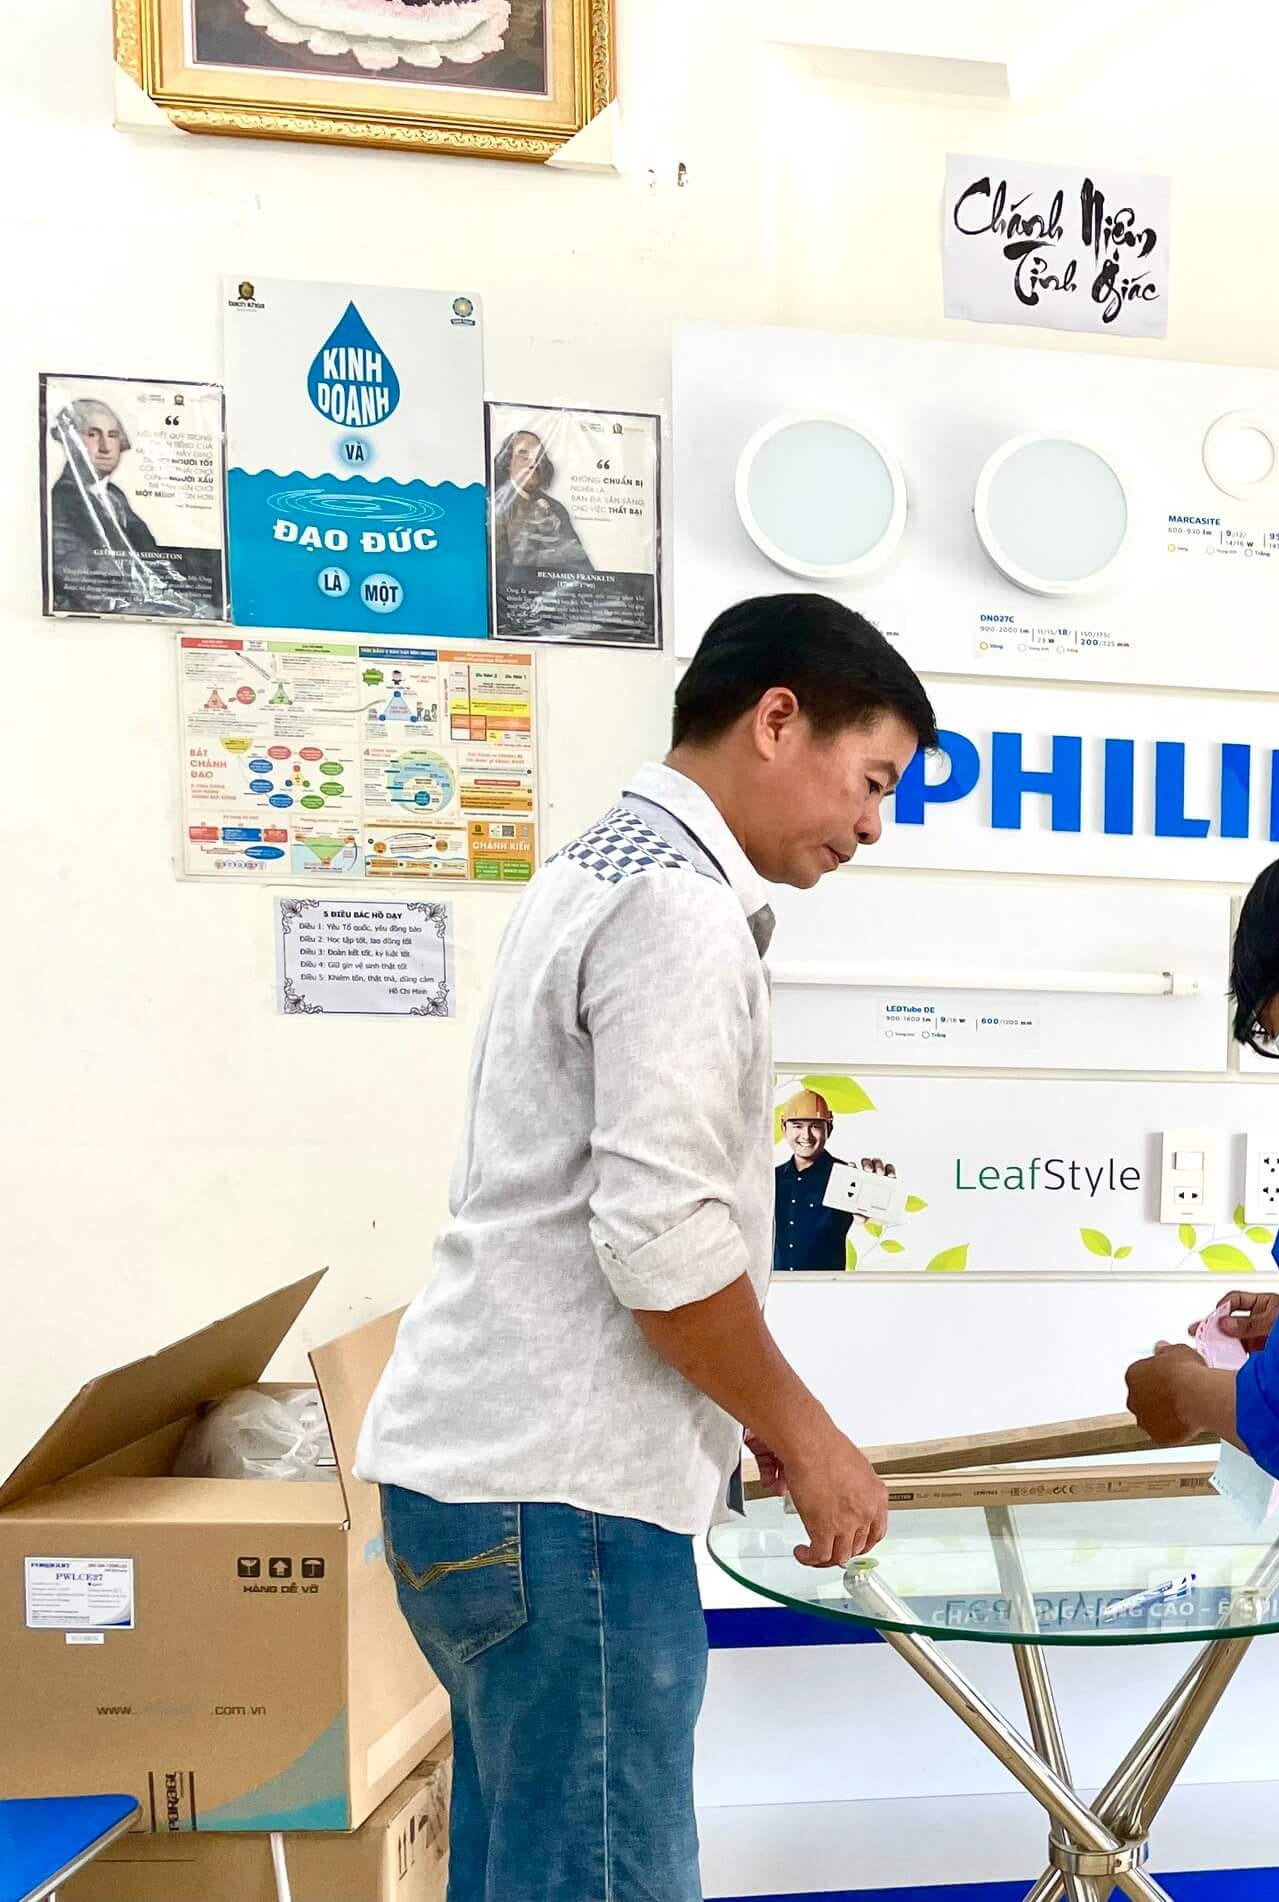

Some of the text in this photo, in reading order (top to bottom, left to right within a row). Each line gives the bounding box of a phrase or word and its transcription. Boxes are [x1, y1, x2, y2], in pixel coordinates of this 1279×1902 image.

[323, 346, 383, 384] KINH
[318, 382, 389, 427] DOANH
[345, 443, 364, 461] VÀ
[1168, 515, 1221, 526] MARCASITE
[273, 519, 438, 553] ĐẠO ĐỨC
[324, 571, 342, 592] LÀ
[365, 580, 399, 603] MỘT
[980, 614, 1015, 624] DN027C
[886, 1005, 922, 1013] LEDTube
[955, 1156, 1141, 1197] LeafStyle
[1150, 1602, 1194, 1616] CAO
